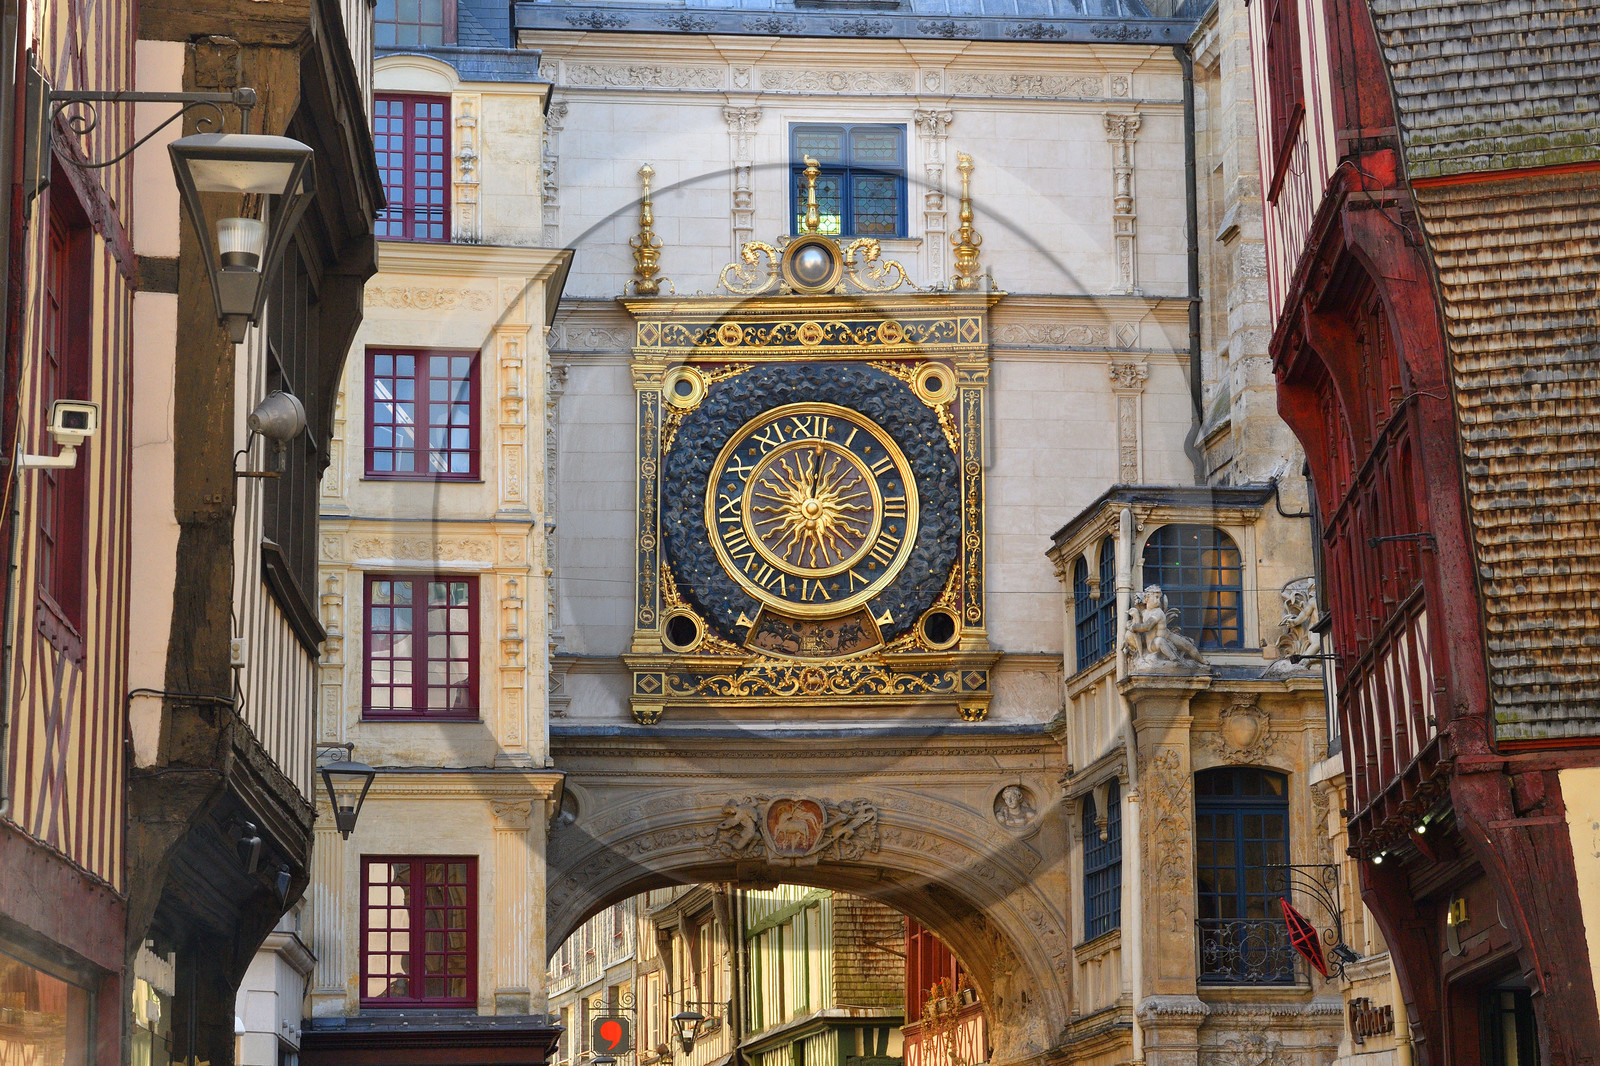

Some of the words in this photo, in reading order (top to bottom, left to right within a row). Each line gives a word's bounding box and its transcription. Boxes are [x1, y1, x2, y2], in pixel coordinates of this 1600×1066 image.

[751, 422, 787, 455] XI
[790, 416, 829, 439] XII
[844, 426, 859, 447] I
[726, 454, 755, 483] X
[870, 455, 895, 477] II
[719, 493, 742, 523] IX
[884, 496, 906, 518] III
[723, 528, 756, 573] VIII
[868, 530, 901, 567] IIII
[753, 562, 788, 597] VII
[800, 579, 832, 601] VI
[848, 569, 870, 593] V
